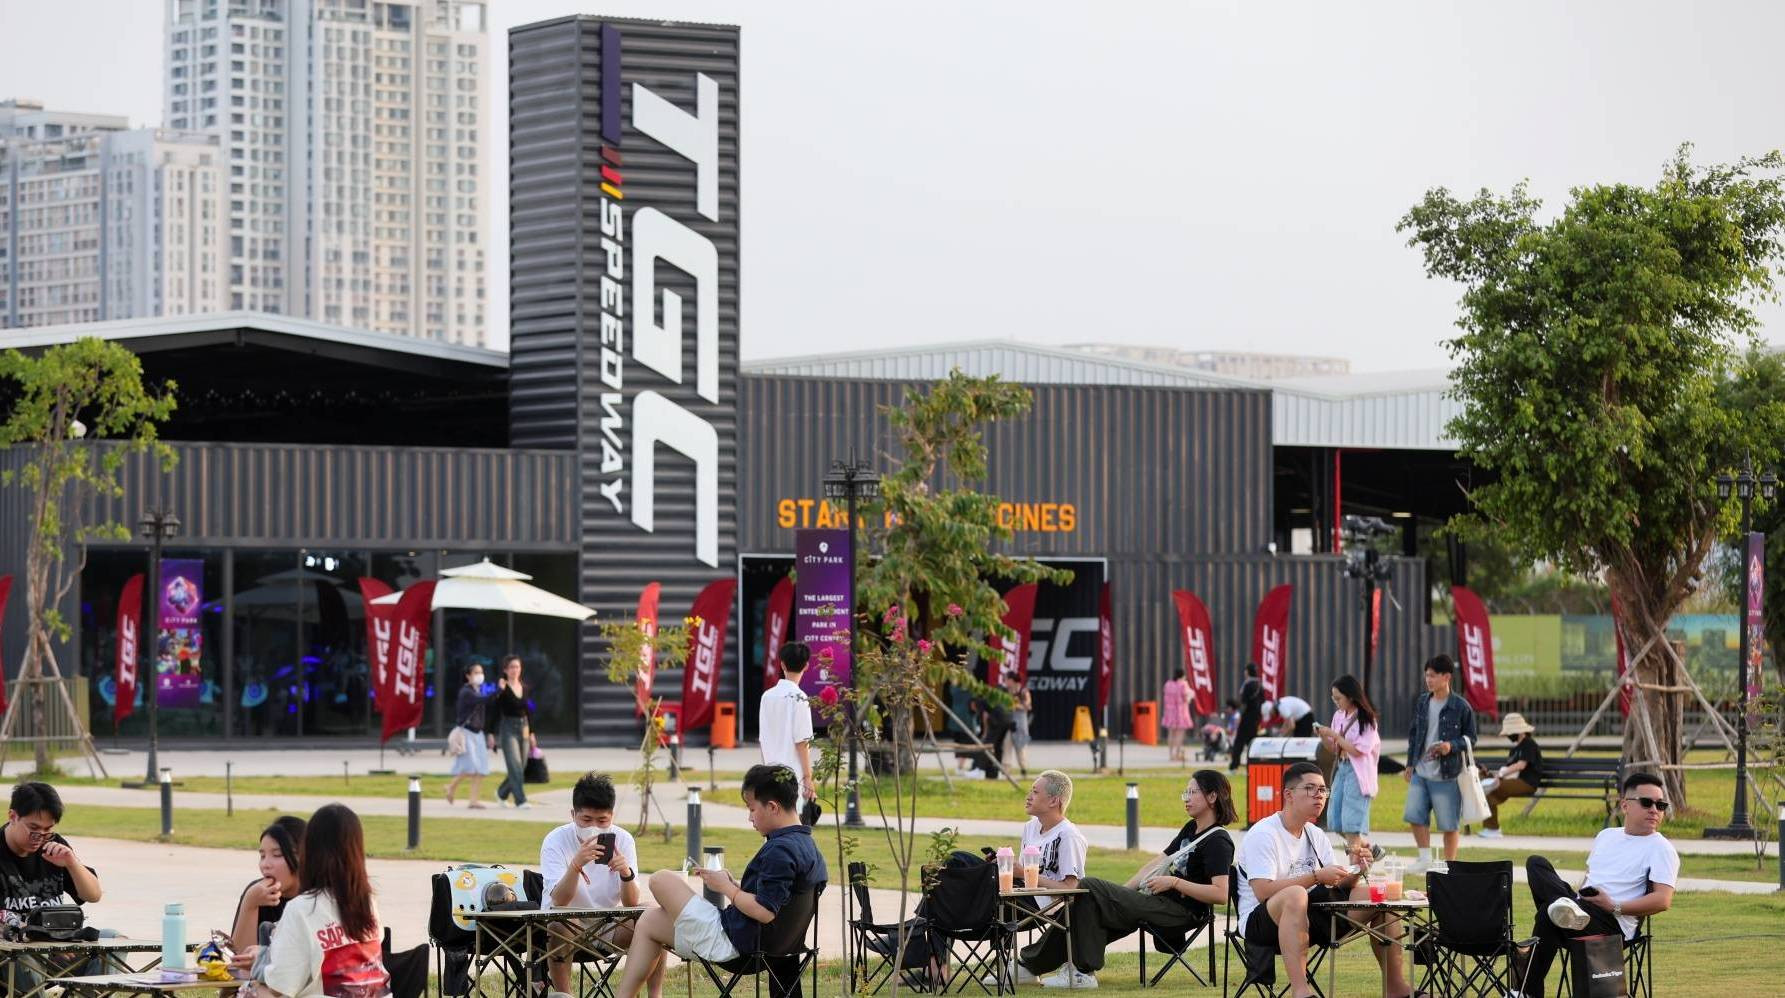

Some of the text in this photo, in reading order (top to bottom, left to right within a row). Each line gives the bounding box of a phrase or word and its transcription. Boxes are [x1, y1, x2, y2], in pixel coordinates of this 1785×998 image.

[600, 197, 624, 514] SPEEDWAY
[632, 72, 719, 569] TGC
[777, 499, 866, 528] STA
[811, 621, 828, 629] PARK
[817, 594, 845, 602] LARGEST
[120, 614, 137, 691] TGC
[394, 619, 418, 705] TGC
[692, 620, 716, 702] TGC
[1187, 626, 1213, 693] TGC
[1261, 624, 1280, 702] TGC
[1464, 622, 1489, 691] TGC
